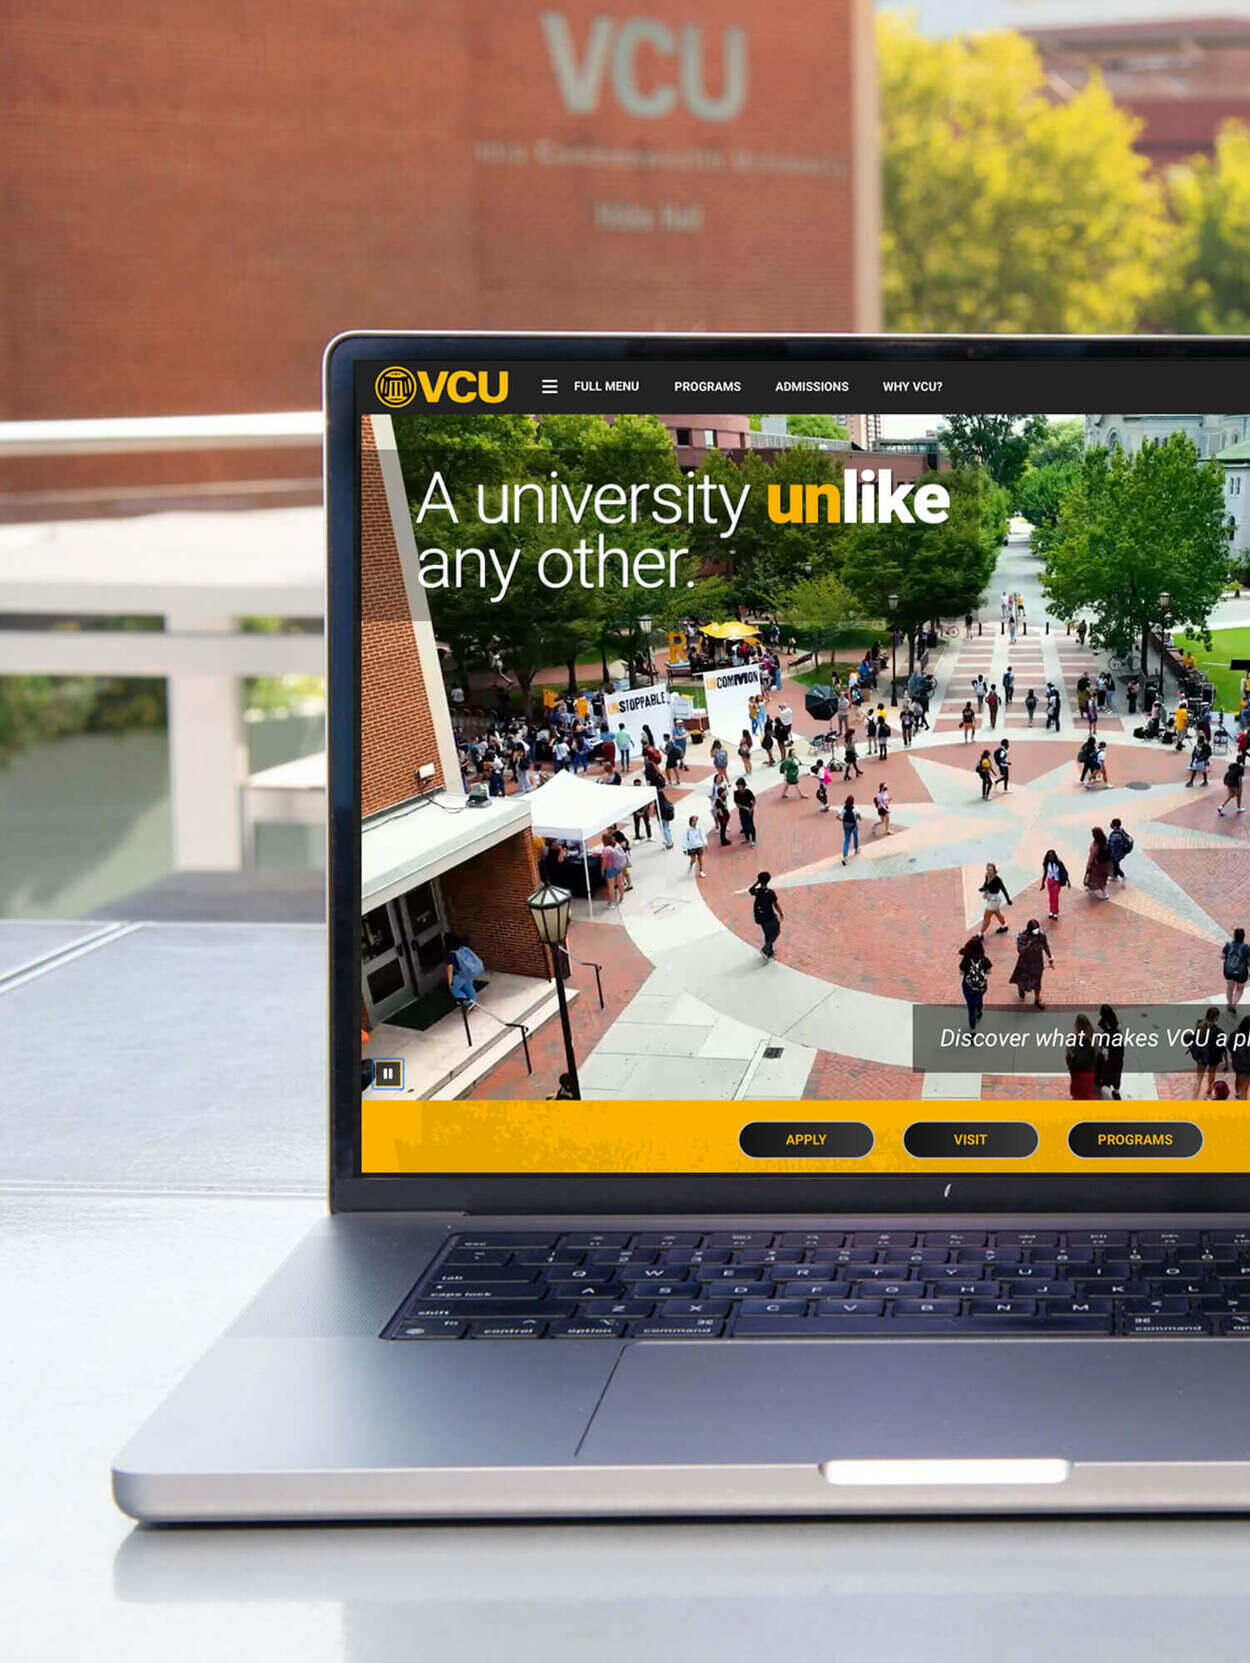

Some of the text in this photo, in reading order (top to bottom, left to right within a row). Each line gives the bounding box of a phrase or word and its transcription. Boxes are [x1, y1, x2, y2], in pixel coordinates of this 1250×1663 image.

[540, 10, 748, 122] VCU
[416, 370, 509, 404] VCU
[574, 381, 639, 392] FULL MENU
[674, 381, 741, 392] PROGRAMS
[775, 381, 849, 392] ADMISSIONS
[882, 381, 943, 392] WHY VCU?
[416, 468, 951, 539] A university unlike
[417, 533, 695, 603] any other.
[940, 1028, 1031, 1048] Discover
[1036, 1028, 1086, 1047] what
[1091, 1028, 1159, 1048] makes
[1166, 1028, 1210, 1048] VCU
[1215, 1032, 1228, 1047] a
[785, 1133, 827, 1145] APPLY
[953, 1133, 988, 1146] VISIT
[1097, 1133, 1173, 1146] PROGRAMS
[689, 1304, 702, 1312] X
